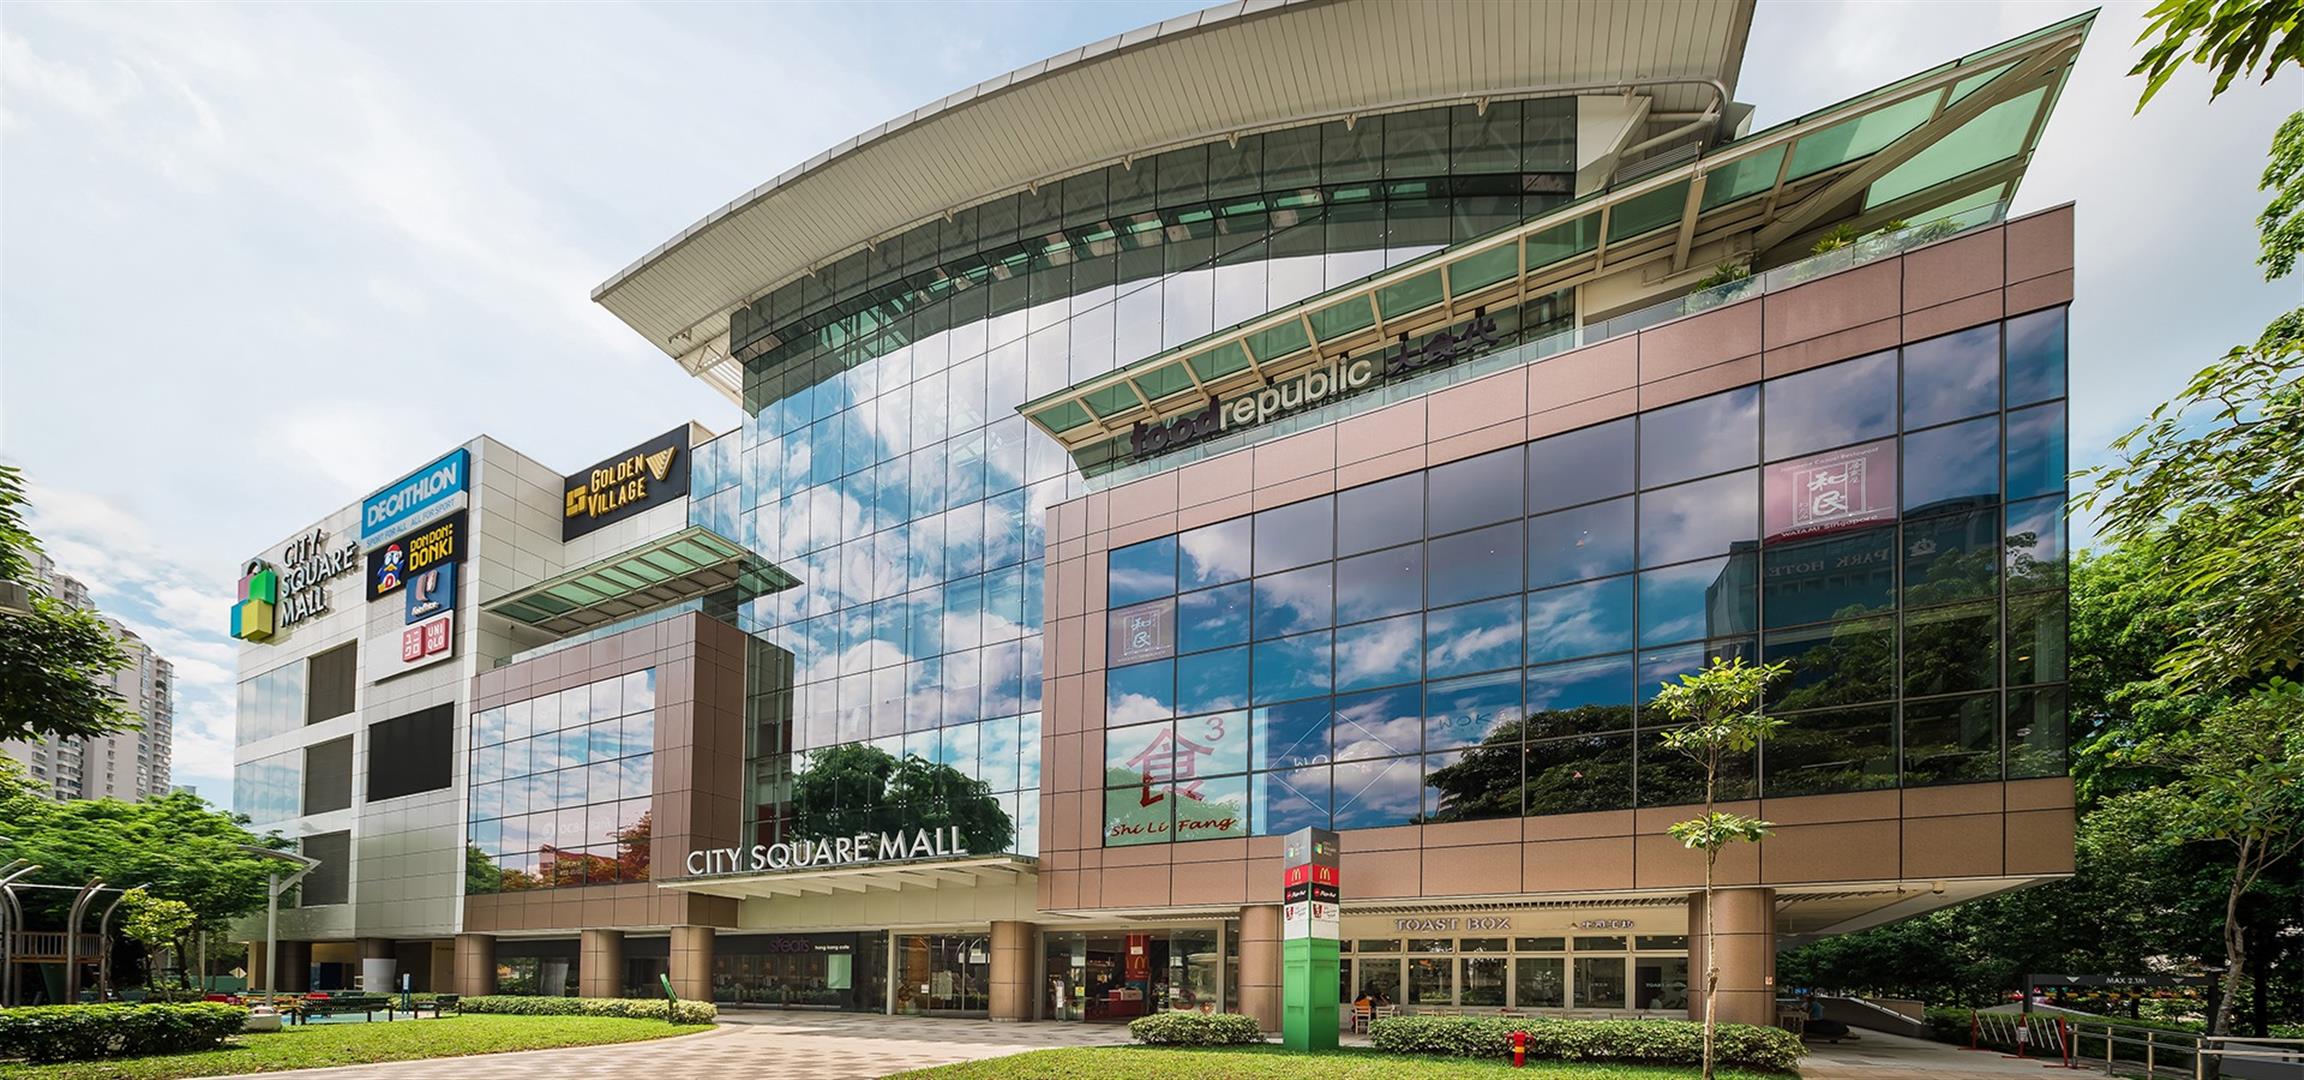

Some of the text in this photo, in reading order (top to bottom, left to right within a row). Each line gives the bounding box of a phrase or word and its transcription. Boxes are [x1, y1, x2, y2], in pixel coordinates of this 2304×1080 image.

[1220, 357, 1372, 432] republic
[591, 454, 644, 493] GOLDEN
[367, 462, 457, 528] DECATHLON
[588, 477, 647, 518] VILLAGE
[282, 541, 357, 597] SQUARE
[284, 529, 321, 568] CITY
[281, 587, 329, 628] MALL
[1147, 820, 1169, 834] Li
[1178, 817, 1238, 832] Fang
[686, 825, 966, 875] CITY SQUARE MALL
[1395, 916, 1512, 931] TOAST BOX
[2105, 976, 2126, 985] MAX
